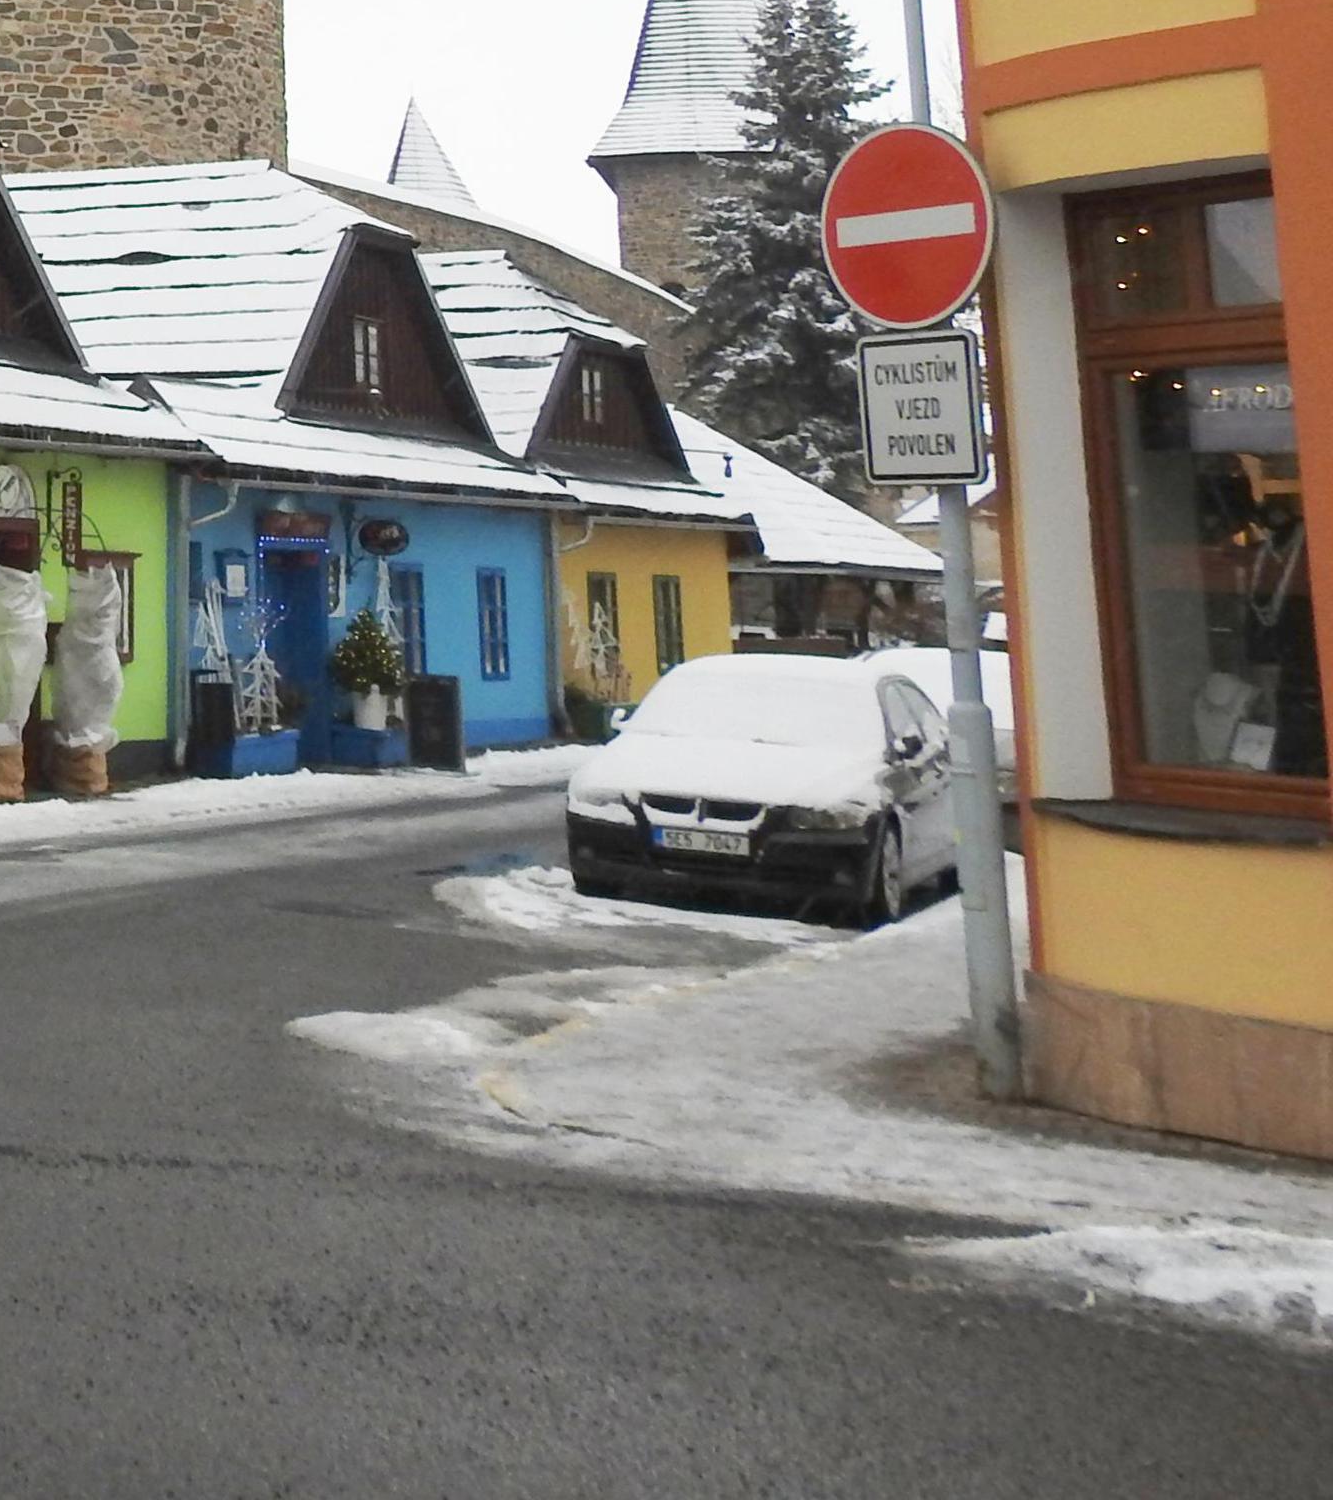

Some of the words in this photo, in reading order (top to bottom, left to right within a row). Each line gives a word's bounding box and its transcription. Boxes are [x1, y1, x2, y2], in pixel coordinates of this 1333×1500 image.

[874, 354, 958, 386] CYKLISTŮM
[895, 397, 941, 420] VJEZD
[888, 433, 956, 456] POVOLEN
